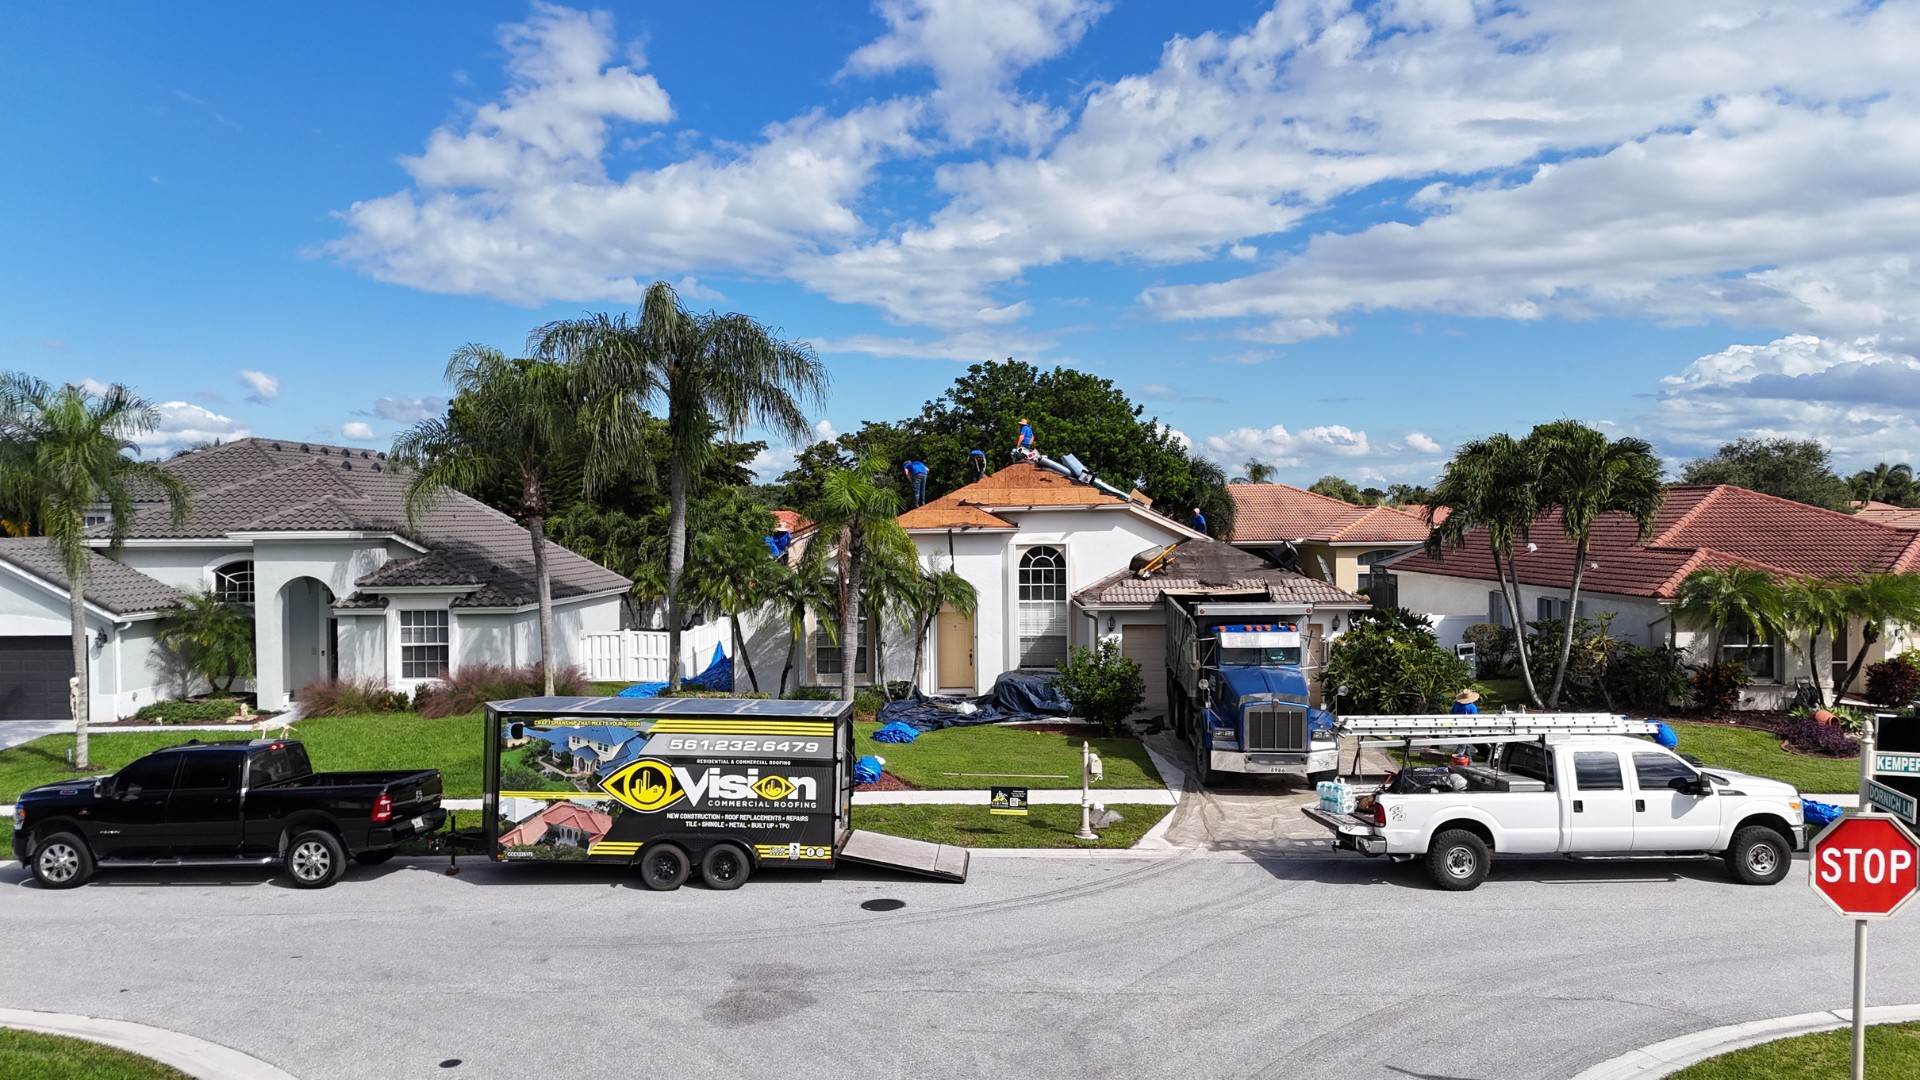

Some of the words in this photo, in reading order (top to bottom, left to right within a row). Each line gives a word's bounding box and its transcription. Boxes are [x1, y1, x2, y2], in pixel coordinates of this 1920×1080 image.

[669, 739, 819, 753] 561.232.6479
[707, 800, 770, 808] COMMERCIAL
[774, 801, 817, 809] ROOFING
[1869, 784, 1902, 813] DORNICH
[1903, 800, 1913, 819] LN
[1821, 847, 1912, 884] STOP
